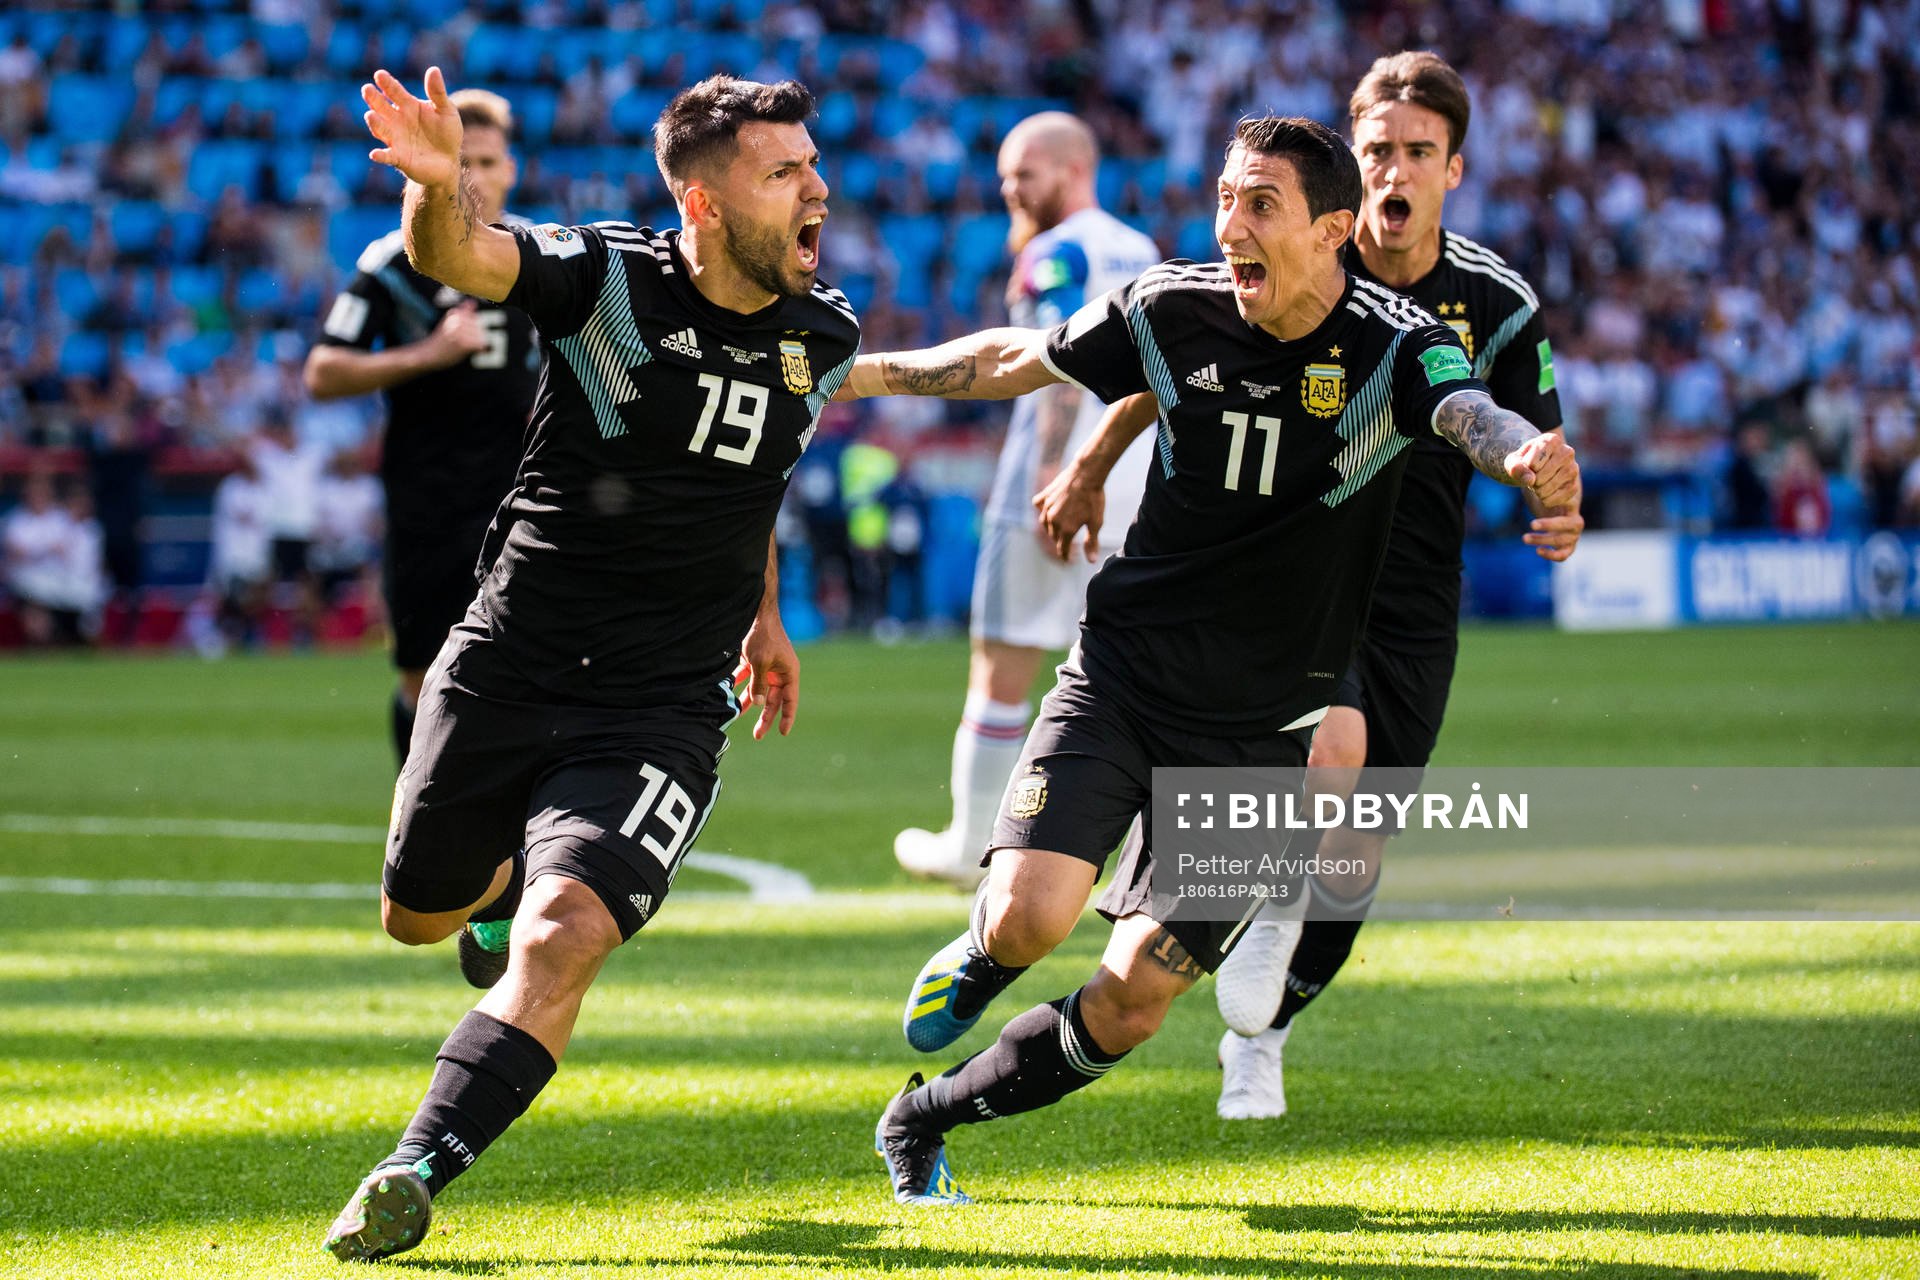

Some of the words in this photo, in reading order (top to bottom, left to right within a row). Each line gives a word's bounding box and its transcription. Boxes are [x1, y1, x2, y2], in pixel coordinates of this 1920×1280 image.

[660, 338, 703, 359] adidas
[1186, 376, 1225, 393] adidas
[1312, 378, 1336, 402] AFA
[688, 373, 769, 465] 19
[1222, 411, 1282, 496] 11
[619, 762, 696, 870] 19
[628, 894, 649, 921] adidas
